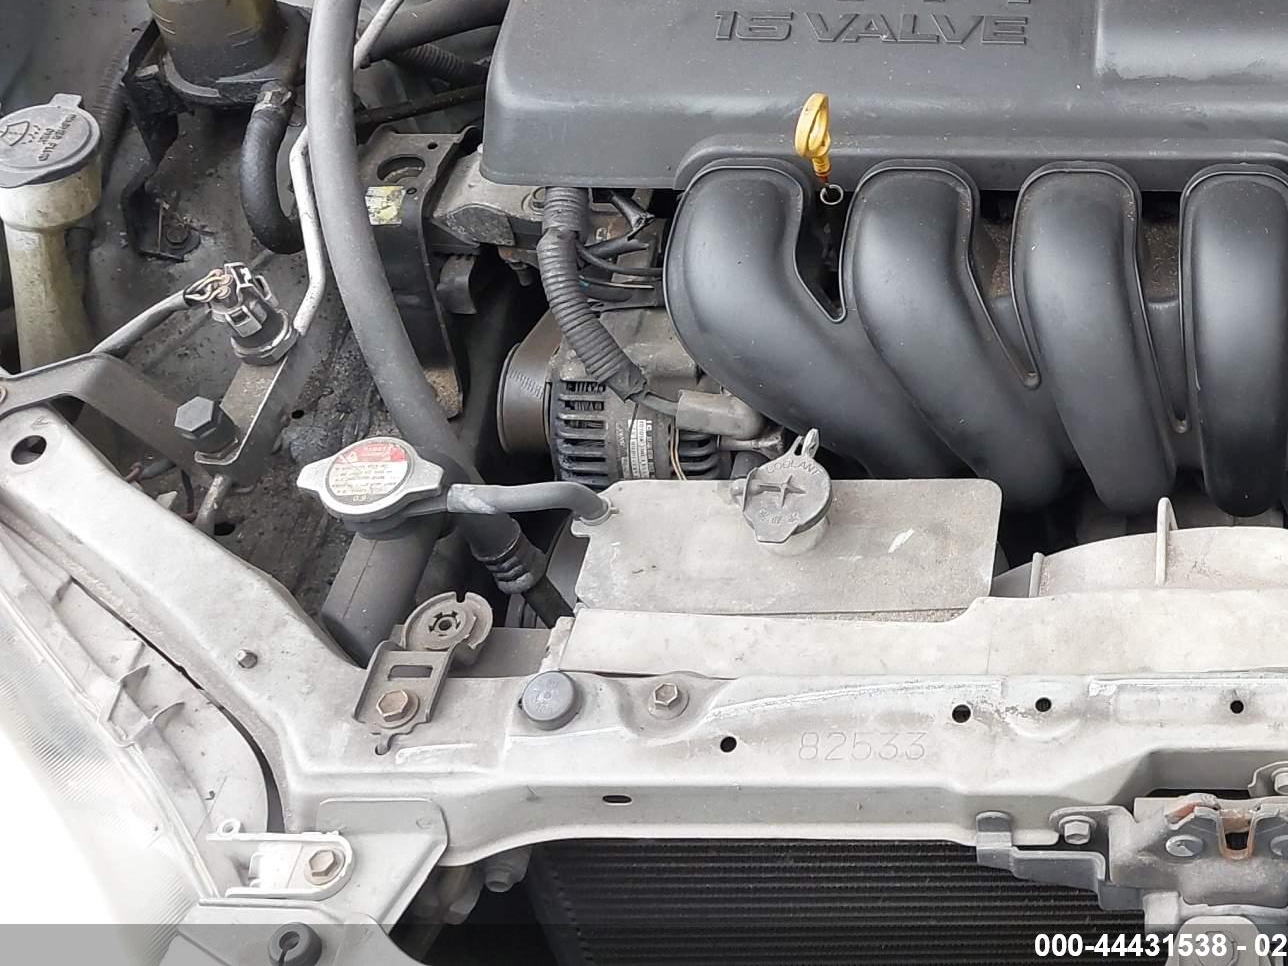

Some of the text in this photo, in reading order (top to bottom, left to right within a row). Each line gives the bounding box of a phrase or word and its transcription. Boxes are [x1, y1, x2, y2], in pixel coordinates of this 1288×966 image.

[714, 10, 1029, 44] 16 VALVE
[767, 459, 821, 474] COOLANT
[799, 732, 927, 761] 82533
